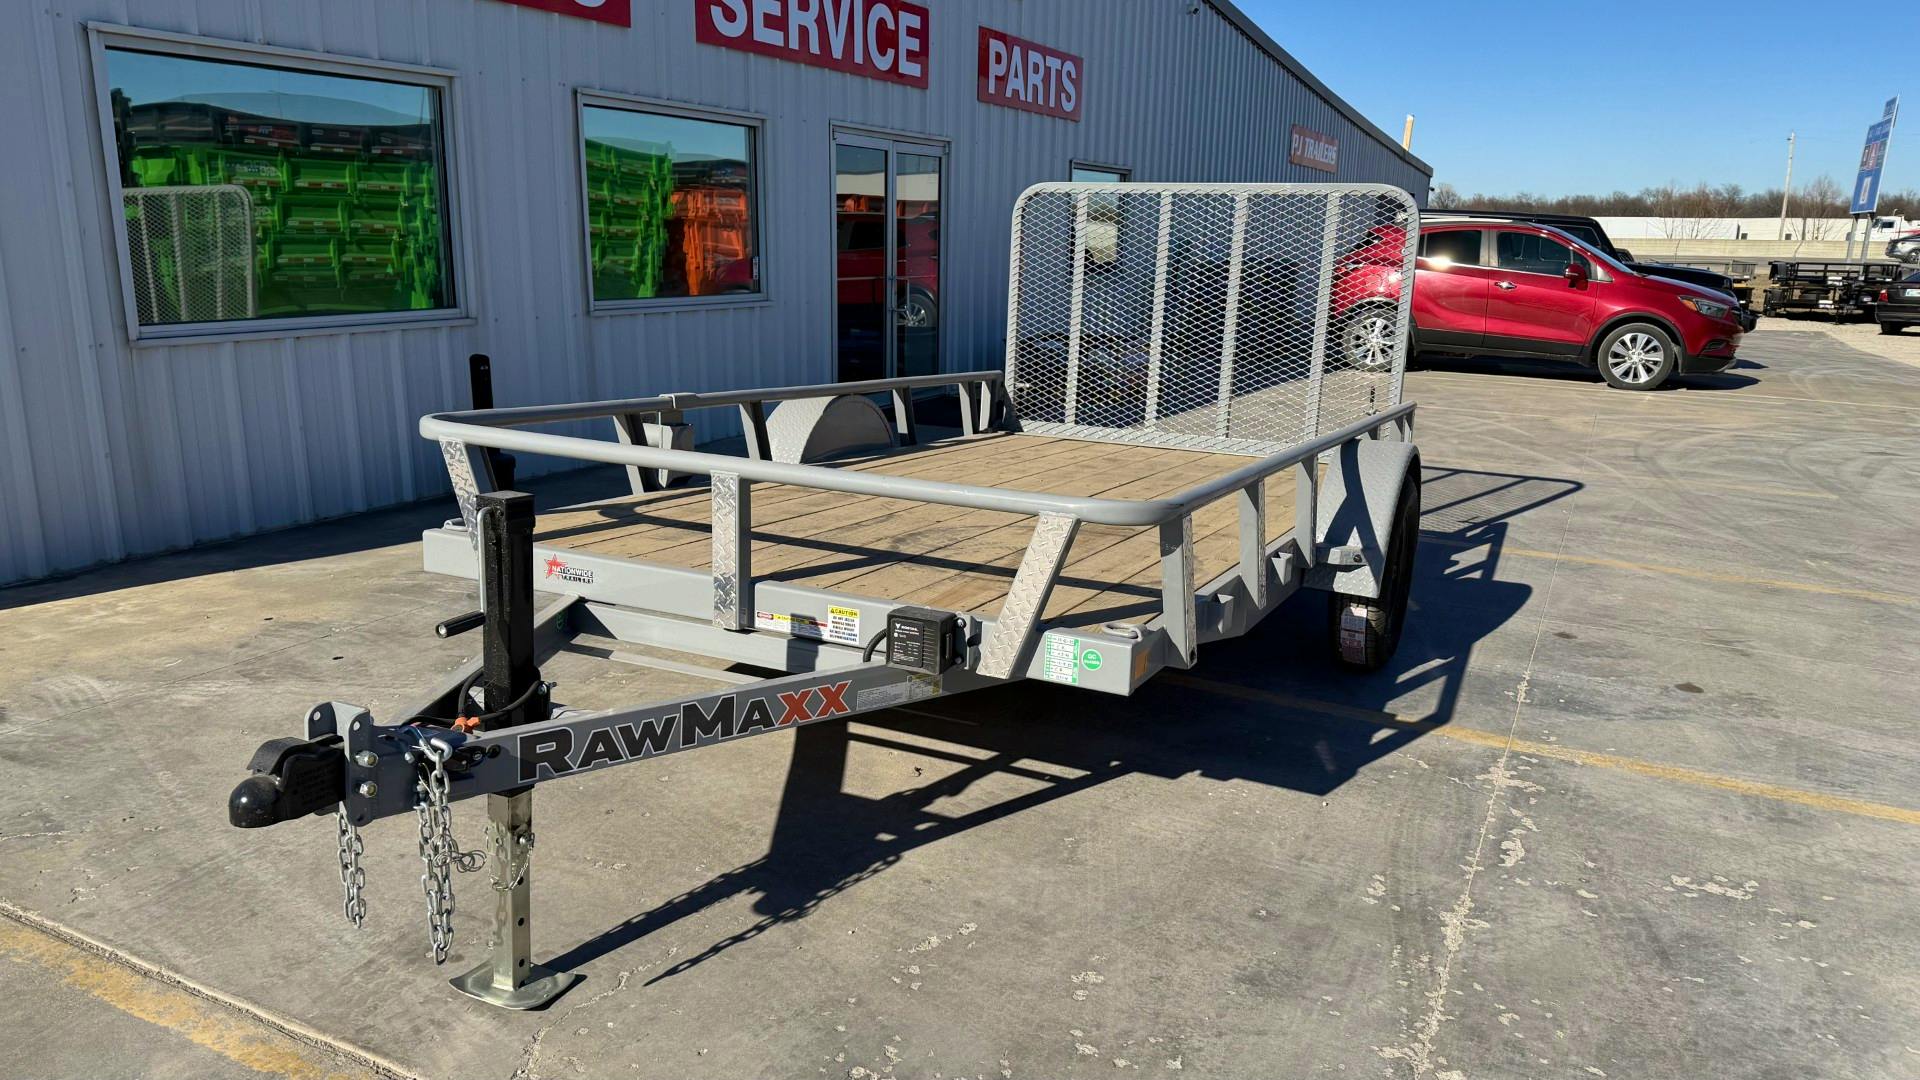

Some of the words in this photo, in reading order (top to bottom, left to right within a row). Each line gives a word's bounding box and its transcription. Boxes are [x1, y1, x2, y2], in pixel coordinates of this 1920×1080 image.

[988, 38, 1077, 112] PARTS
[1292, 134, 1304, 155] PJ
[1304, 138, 1337, 164] TRAILERS
[834, 608, 858, 617] CAUTION
